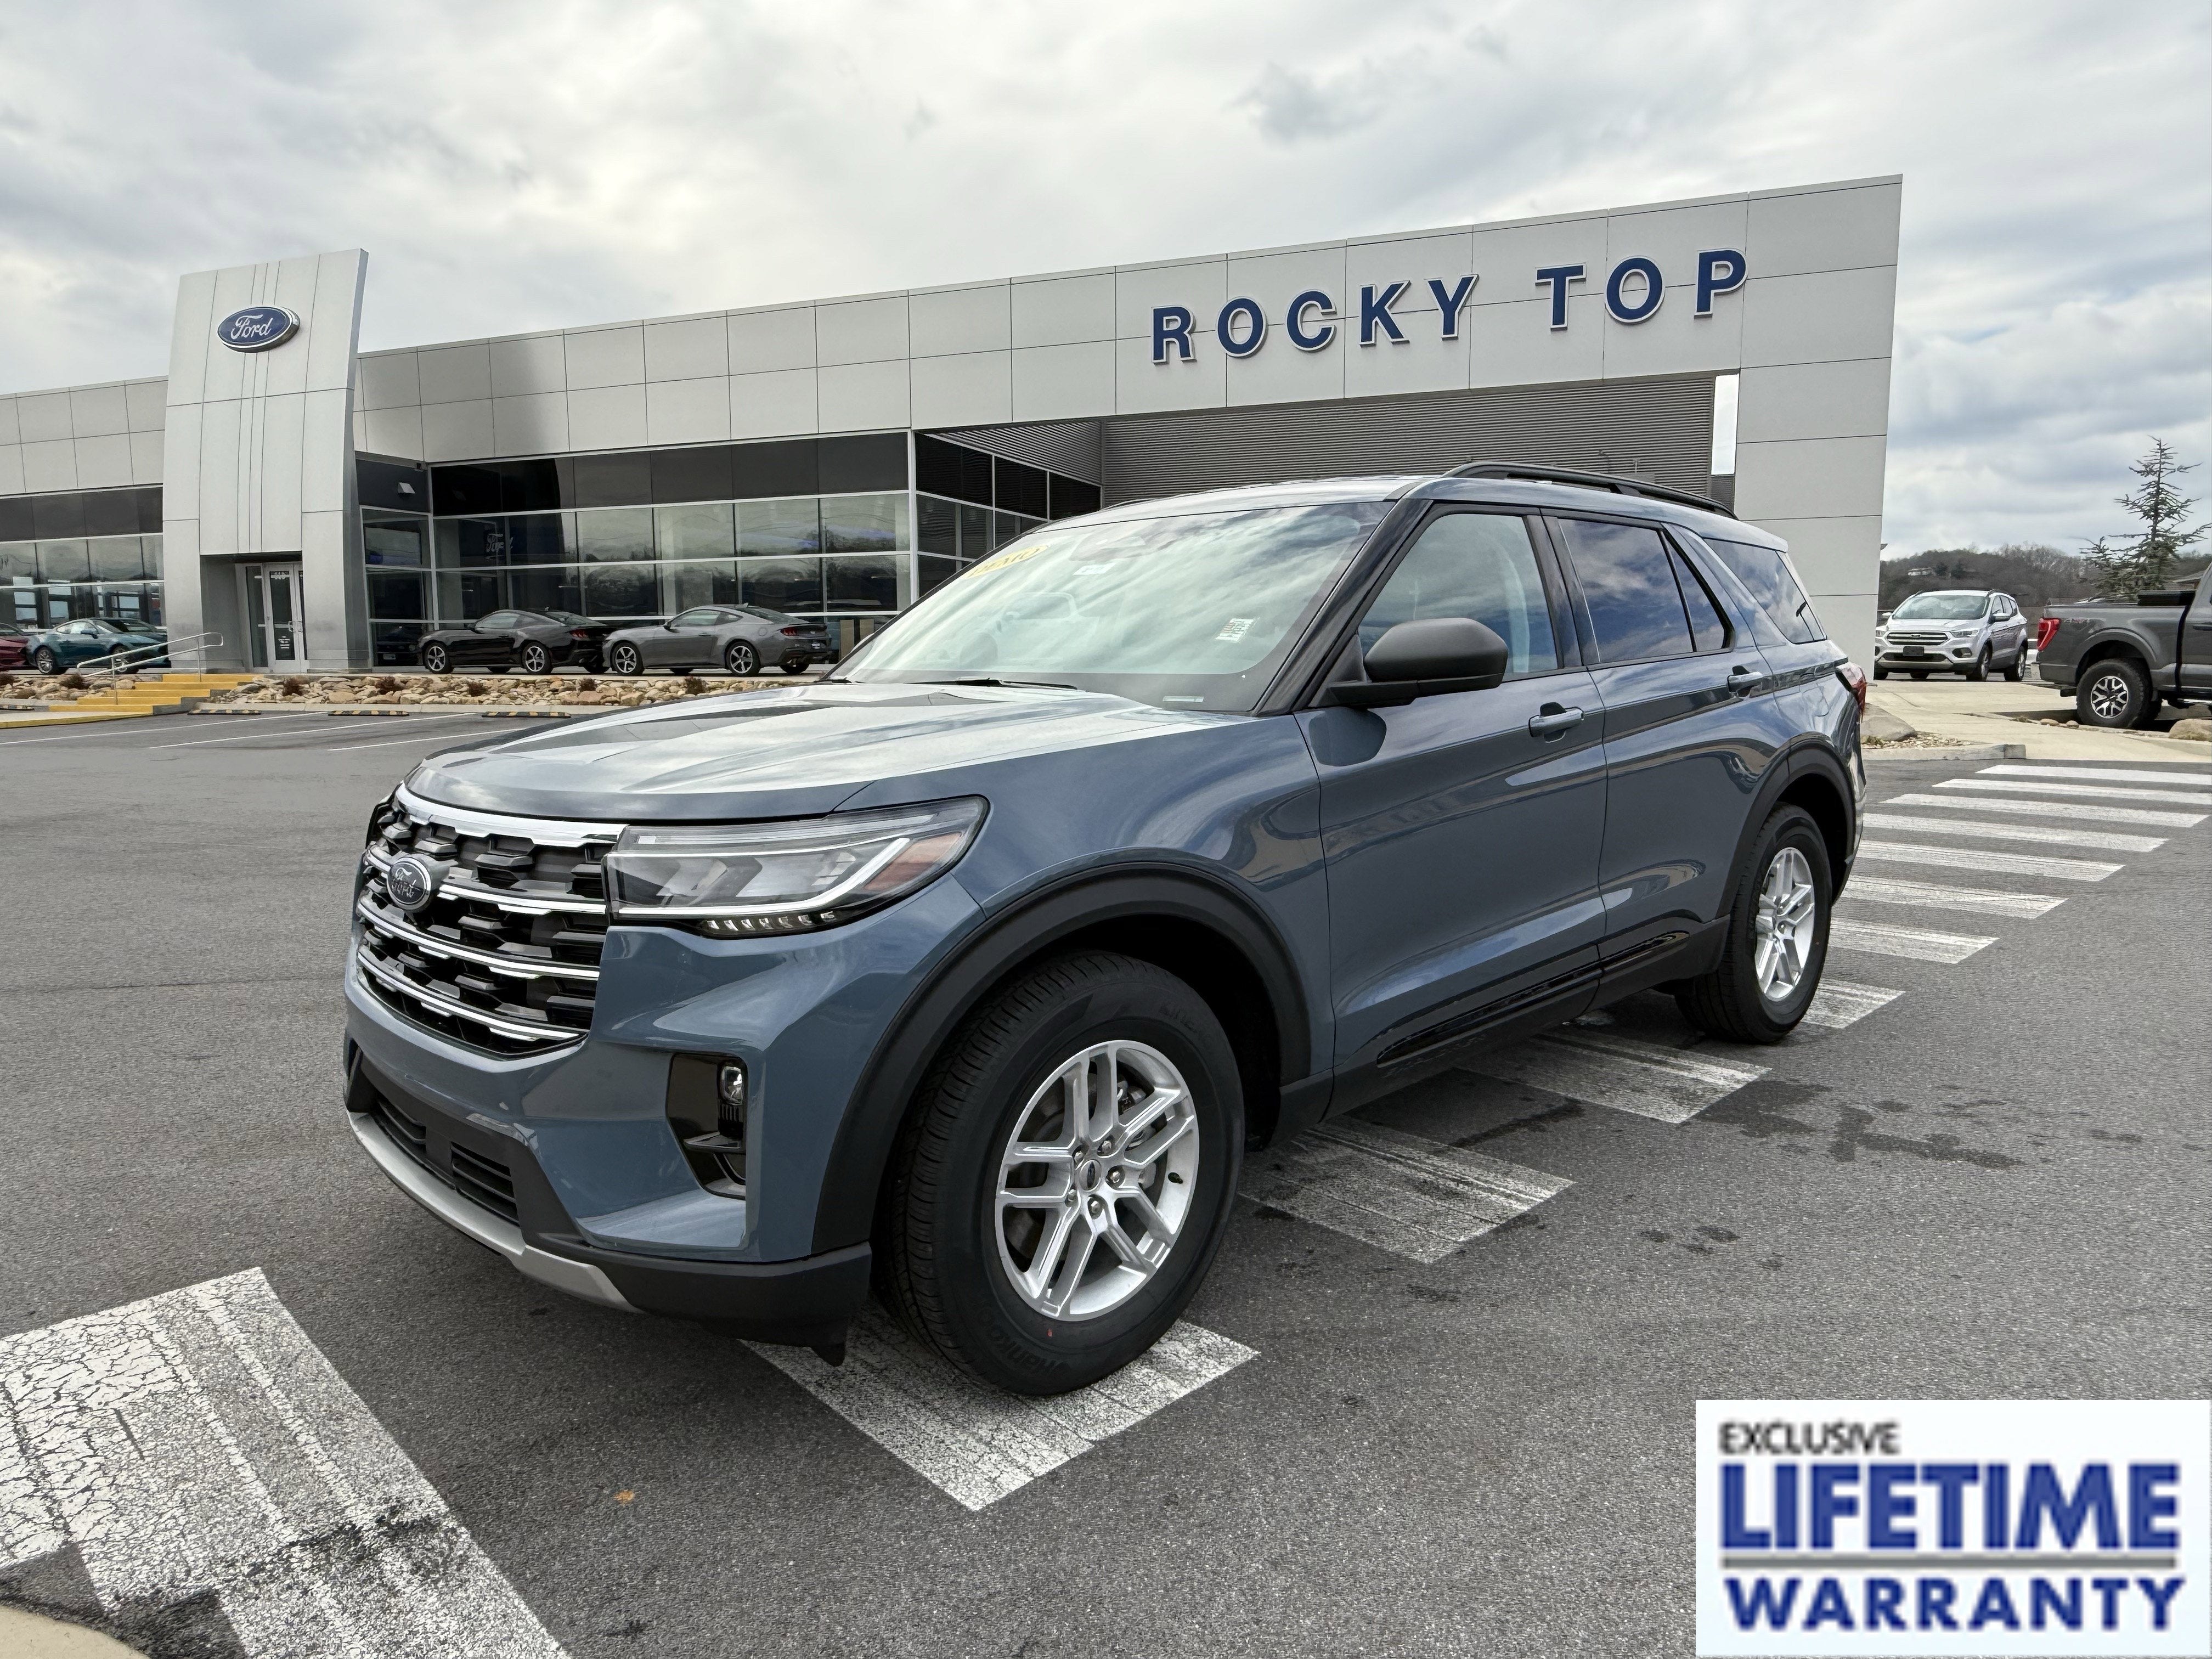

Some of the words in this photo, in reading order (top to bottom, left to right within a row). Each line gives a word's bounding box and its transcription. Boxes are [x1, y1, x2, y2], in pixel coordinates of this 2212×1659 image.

[230, 314, 273, 340] Ford
[1152, 273, 1480, 363] ROCKY
[1535, 248, 1748, 330] TOP
